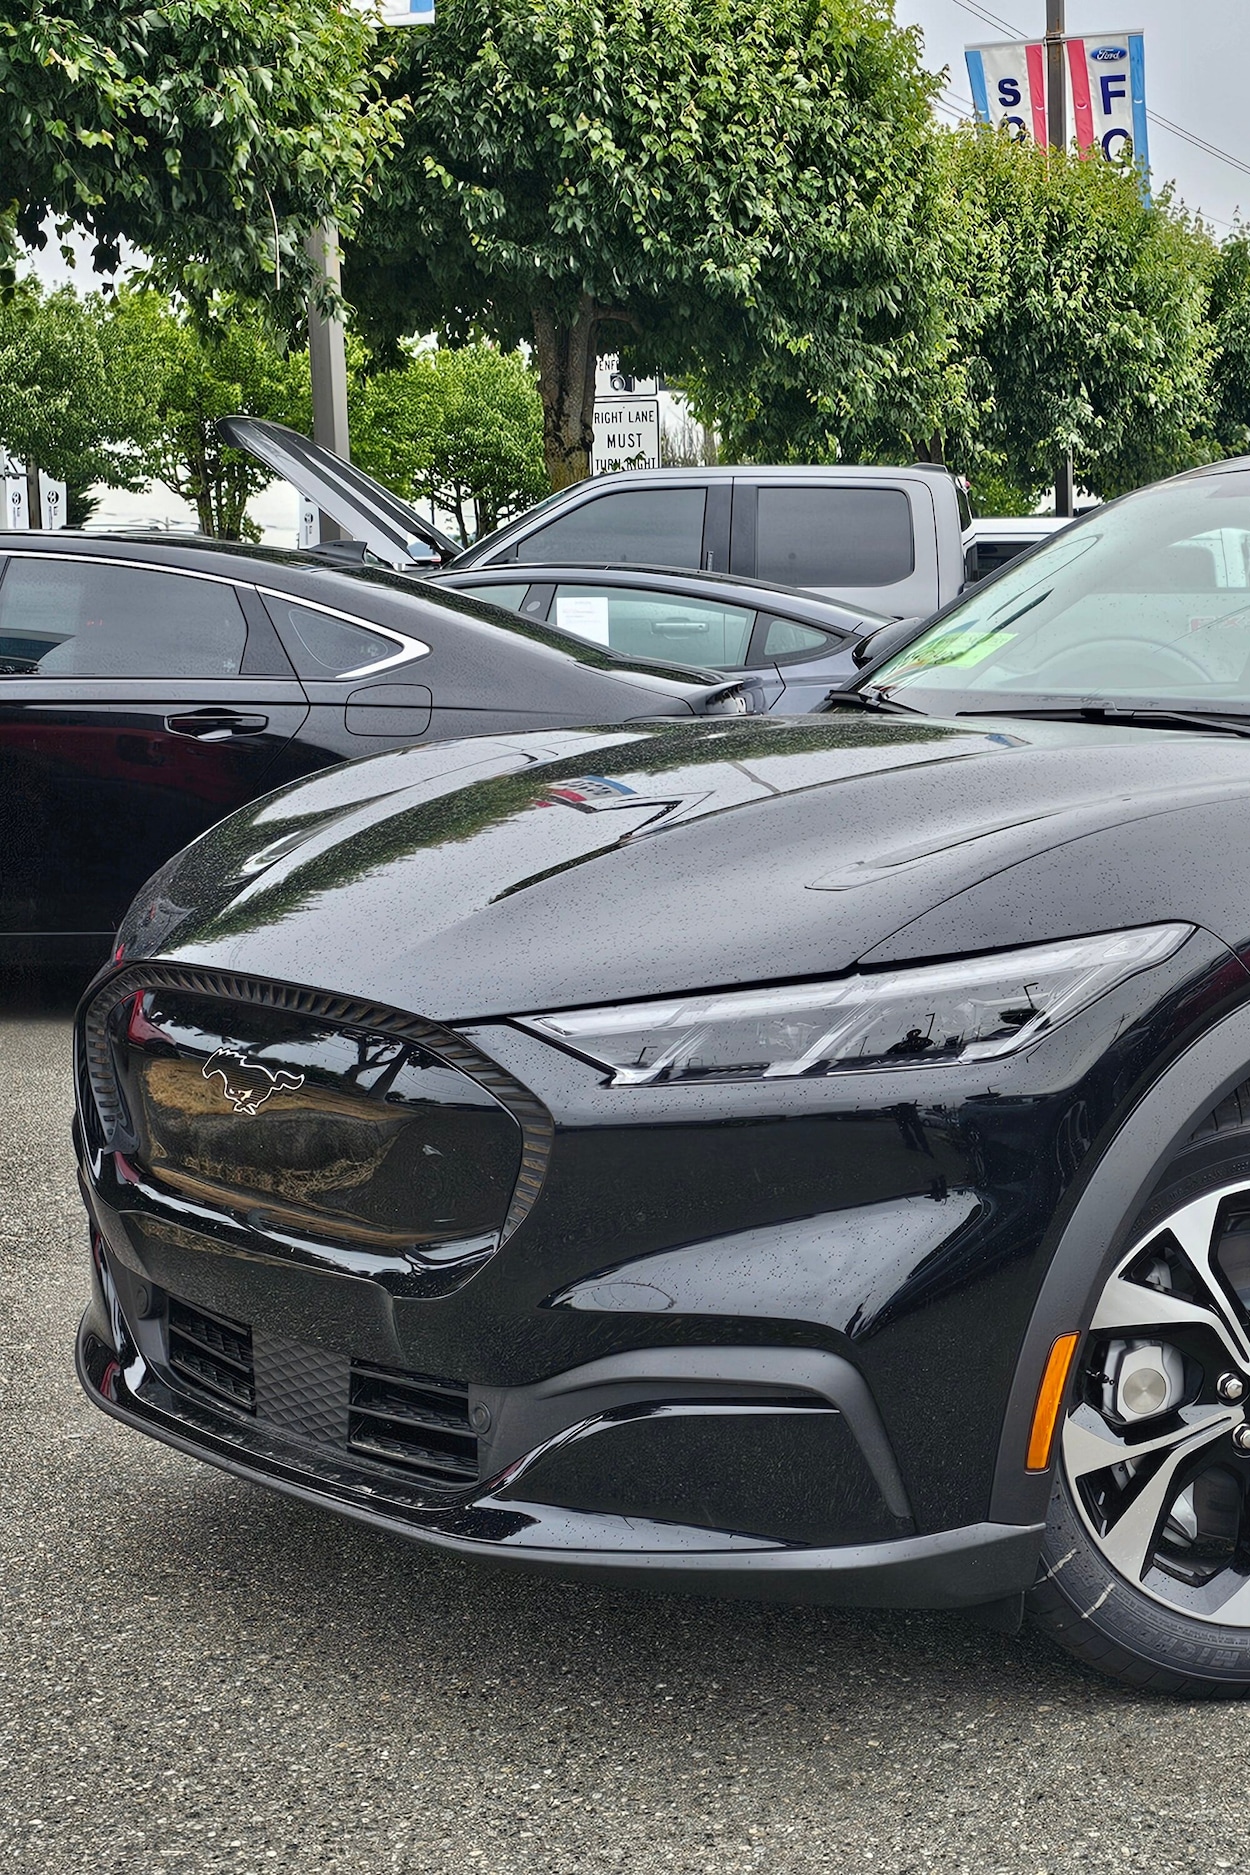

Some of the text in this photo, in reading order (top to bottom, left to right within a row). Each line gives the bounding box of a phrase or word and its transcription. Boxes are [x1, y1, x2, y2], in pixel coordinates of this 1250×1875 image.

[594, 410, 655, 424] RIGHT LANE
[607, 433, 643, 449] MUST
[595, 459, 621, 471] TURN
